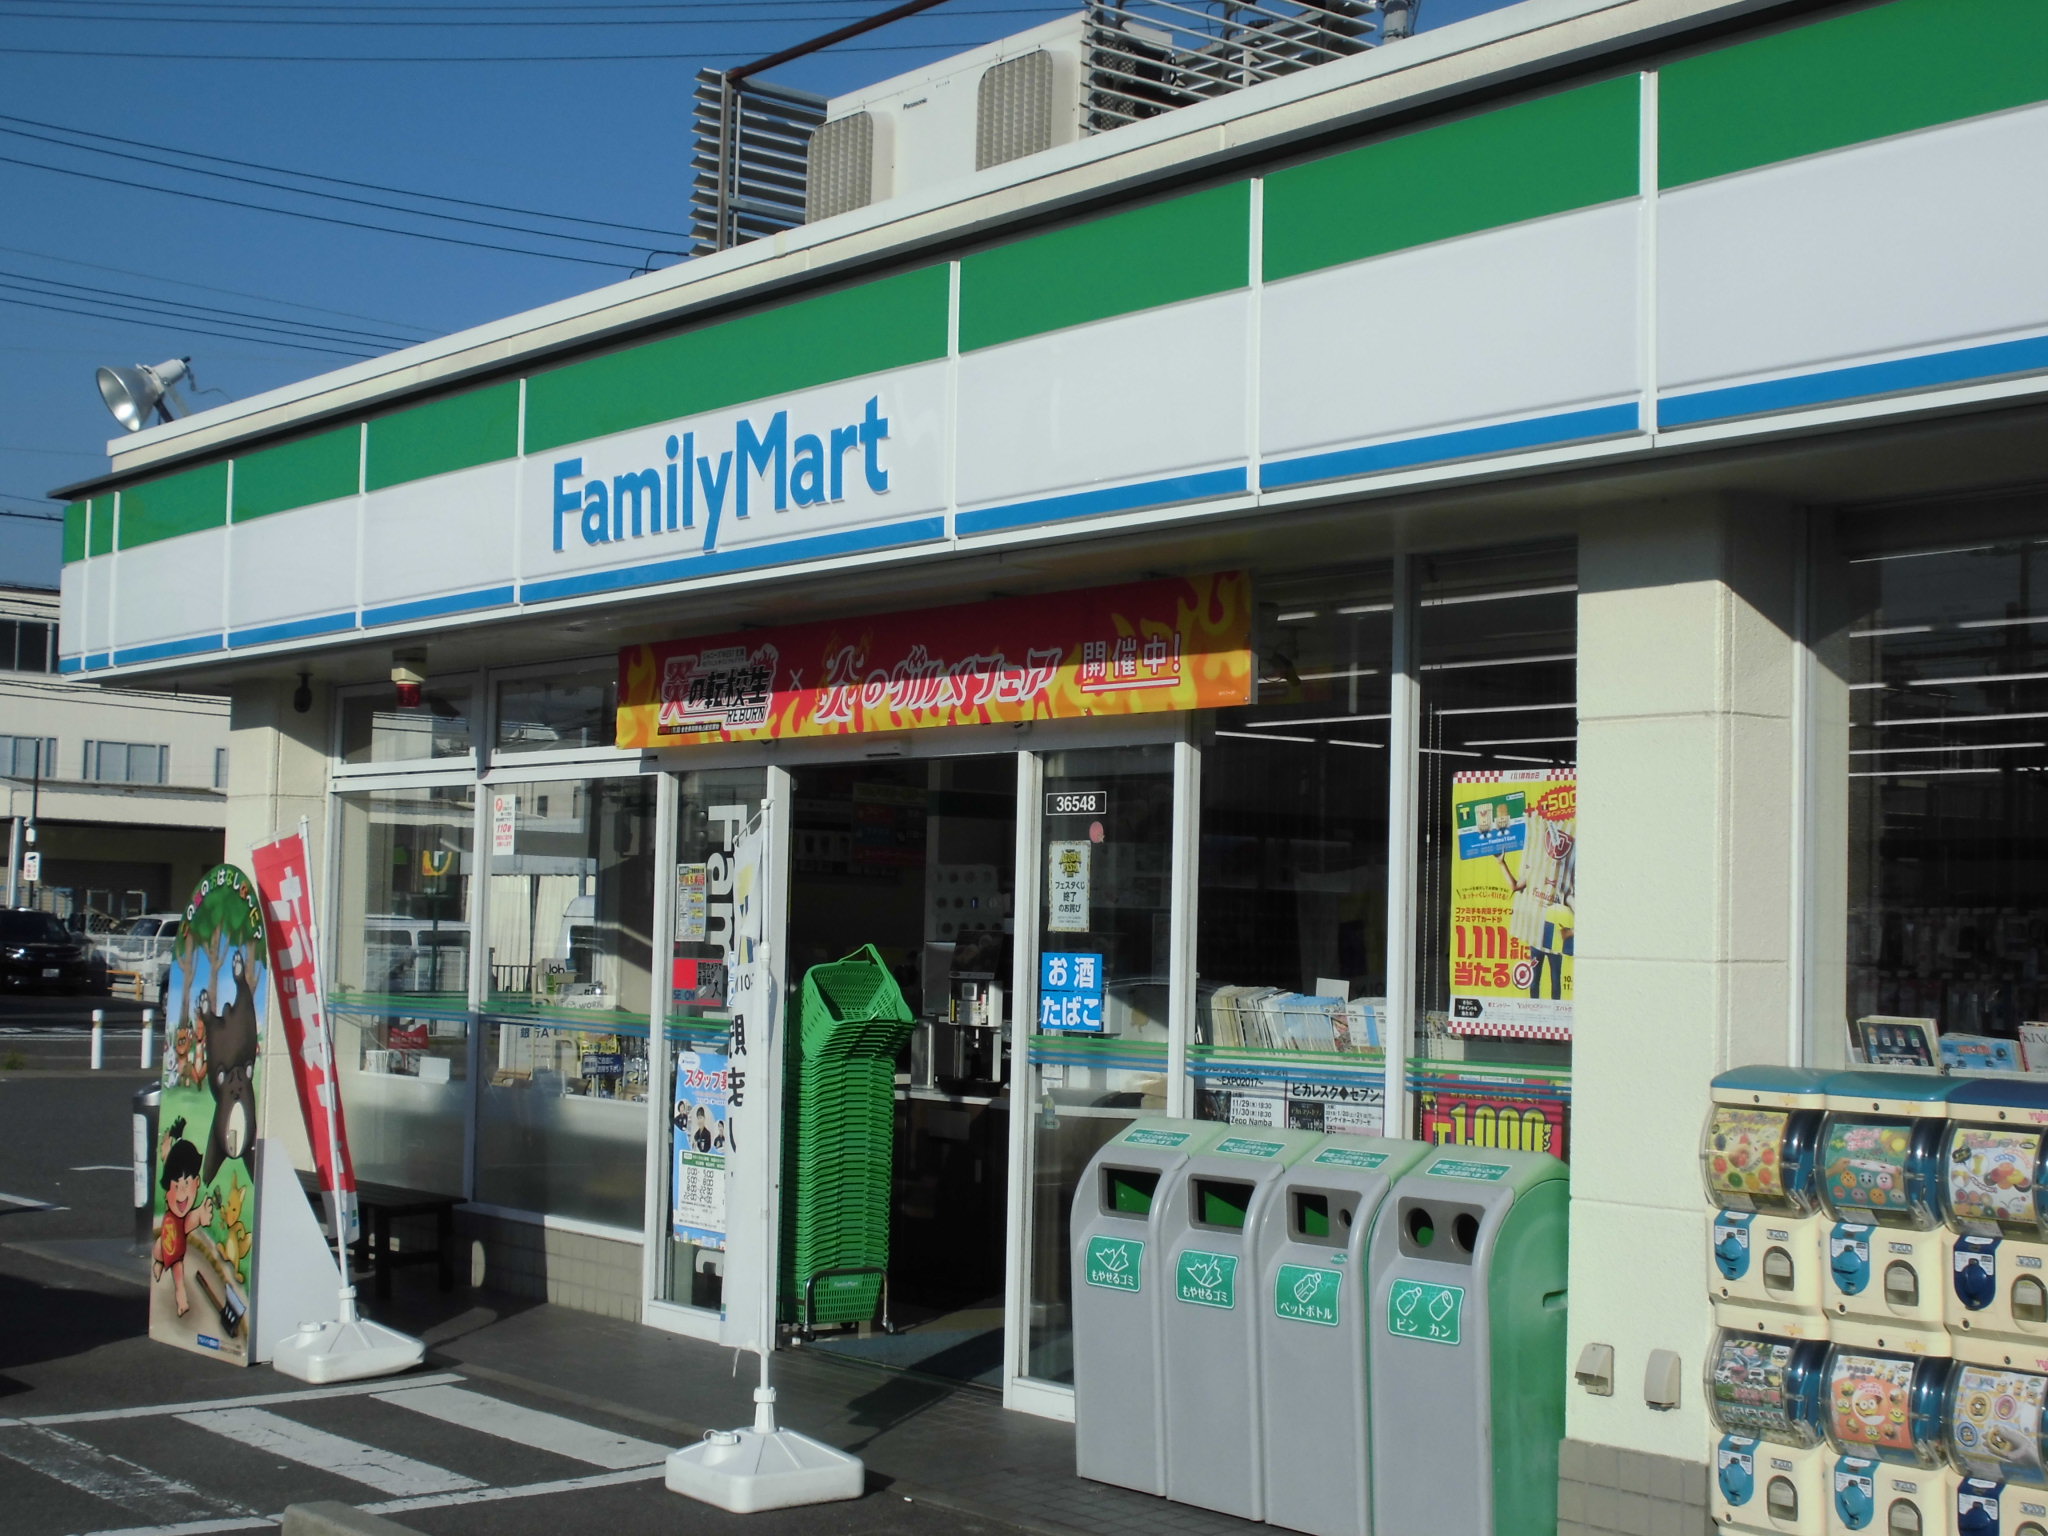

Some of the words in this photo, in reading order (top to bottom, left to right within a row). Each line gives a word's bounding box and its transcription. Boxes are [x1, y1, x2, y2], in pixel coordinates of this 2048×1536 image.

[553, 395, 890, 553] FamilyMart
[1082, 633, 1181, 680] 開催中!
[726, 705, 766, 723] REBORN
[1056, 795, 1097, 812] 36548
[1055, 881, 1086, 890] フェスタくじ
[1063, 891, 1077, 902] 終了
[1048, 956, 1096, 989] お酒
[1454, 961, 1511, 988] 当たる
[1042, 995, 1101, 1027] たばこ
[1249, 1117, 1273, 1127] Namba
[1092, 1269, 1134, 1287] もやせるゴミ
[1182, 1285, 1228, 1303] もやせるゴミ
[1280, 1301, 1333, 1320] ペットボトル
[1429, 1323, 1451, 1338] カン
